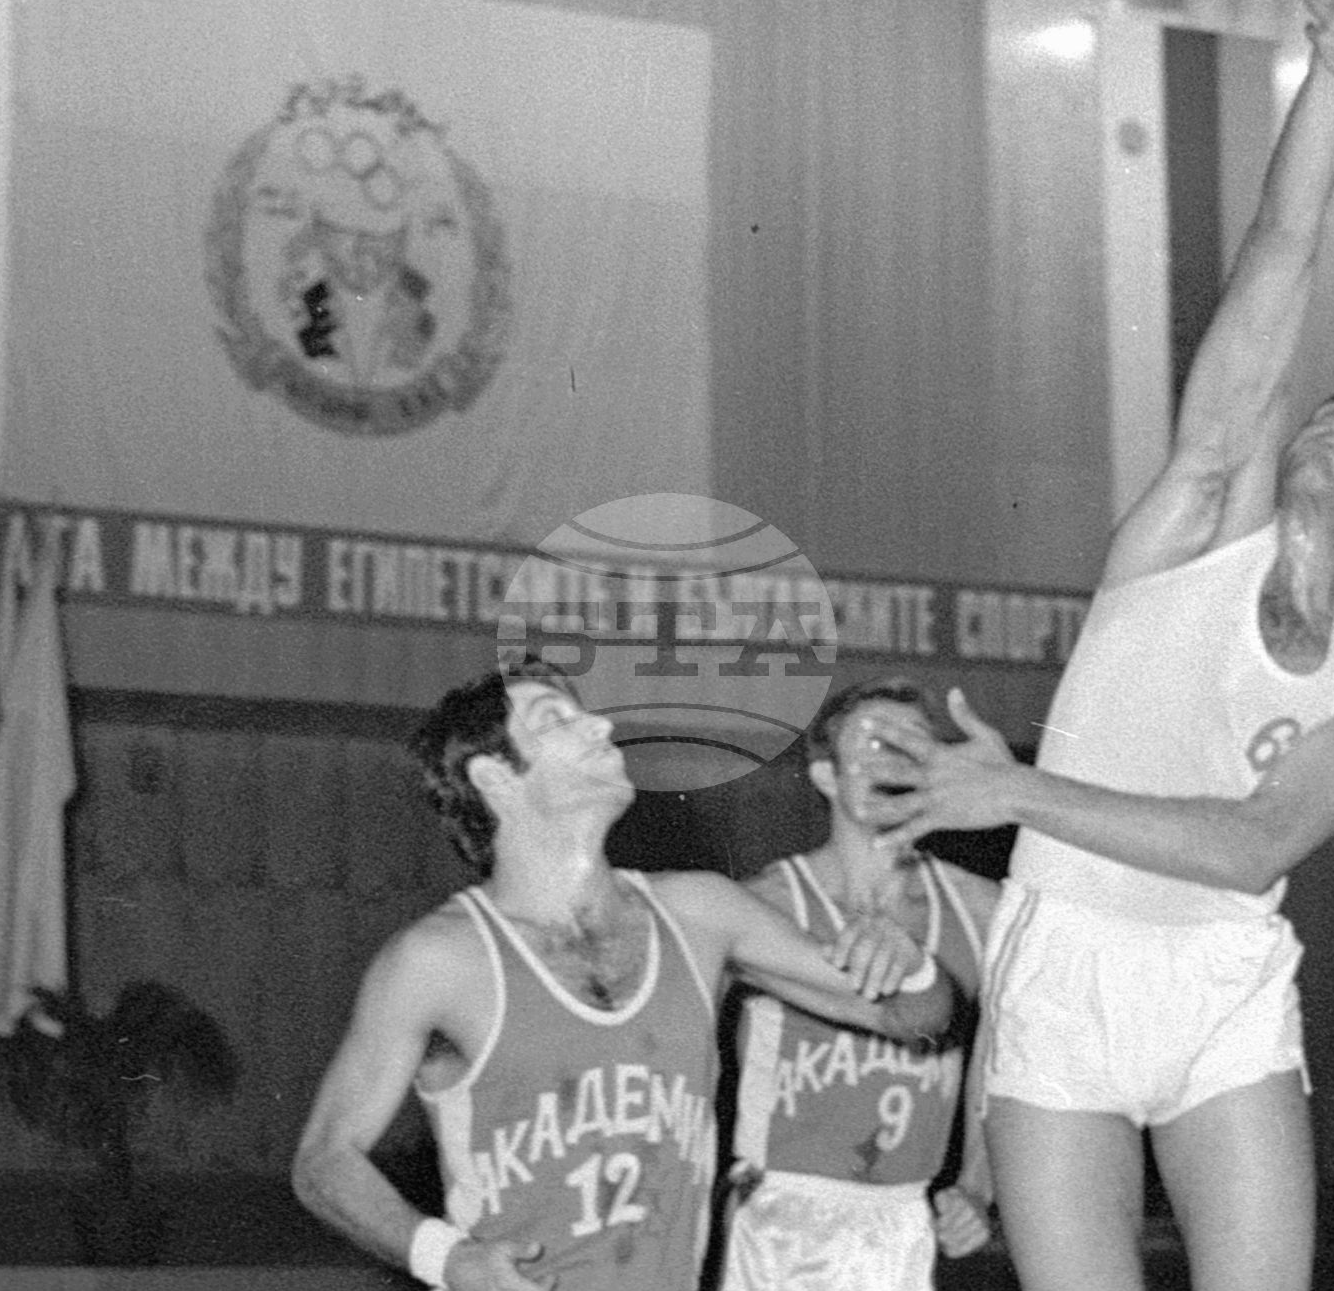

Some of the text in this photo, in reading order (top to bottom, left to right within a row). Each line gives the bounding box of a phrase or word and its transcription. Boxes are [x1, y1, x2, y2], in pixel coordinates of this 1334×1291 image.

[130, 521, 303, 616] МЕЖДУ
[875, 1083, 914, 1152] 9
[564, 1151, 648, 1238] 12
